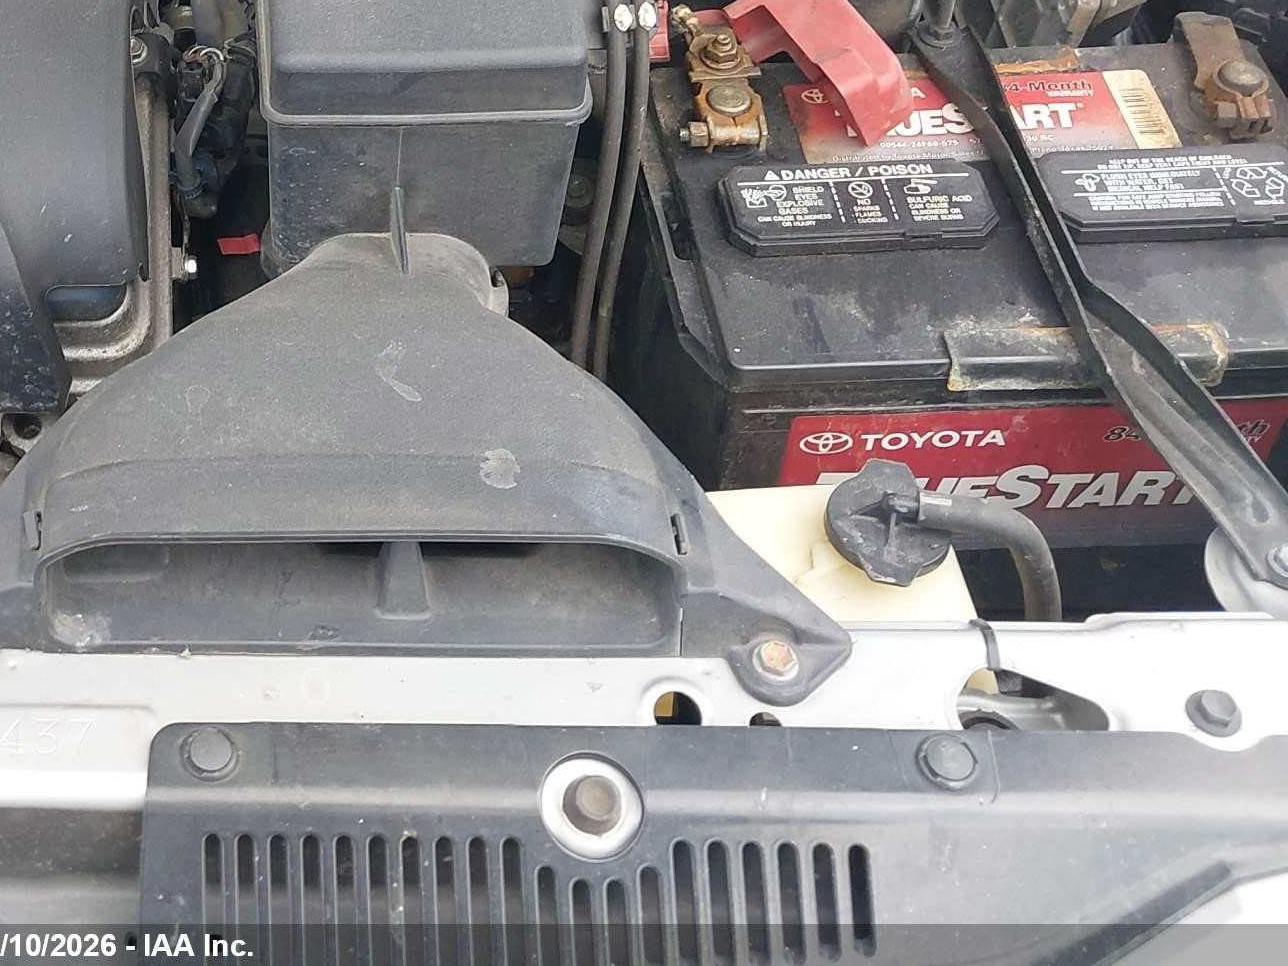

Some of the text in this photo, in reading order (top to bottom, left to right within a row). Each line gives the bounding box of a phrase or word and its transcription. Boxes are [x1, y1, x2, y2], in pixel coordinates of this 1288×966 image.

[1004, 78, 1093, 92] 4-Month
[781, 168, 851, 181] DANGER
[867, 164, 934, 177] POISON
[792, 185, 824, 194] SHIELD
[794, 193, 818, 201] EYES
[906, 195, 949, 204] SULFURIC
[776, 199, 824, 208] EXPLOSIVE
[778, 207, 809, 215] GASES
[861, 430, 1006, 451] TOYOTA
